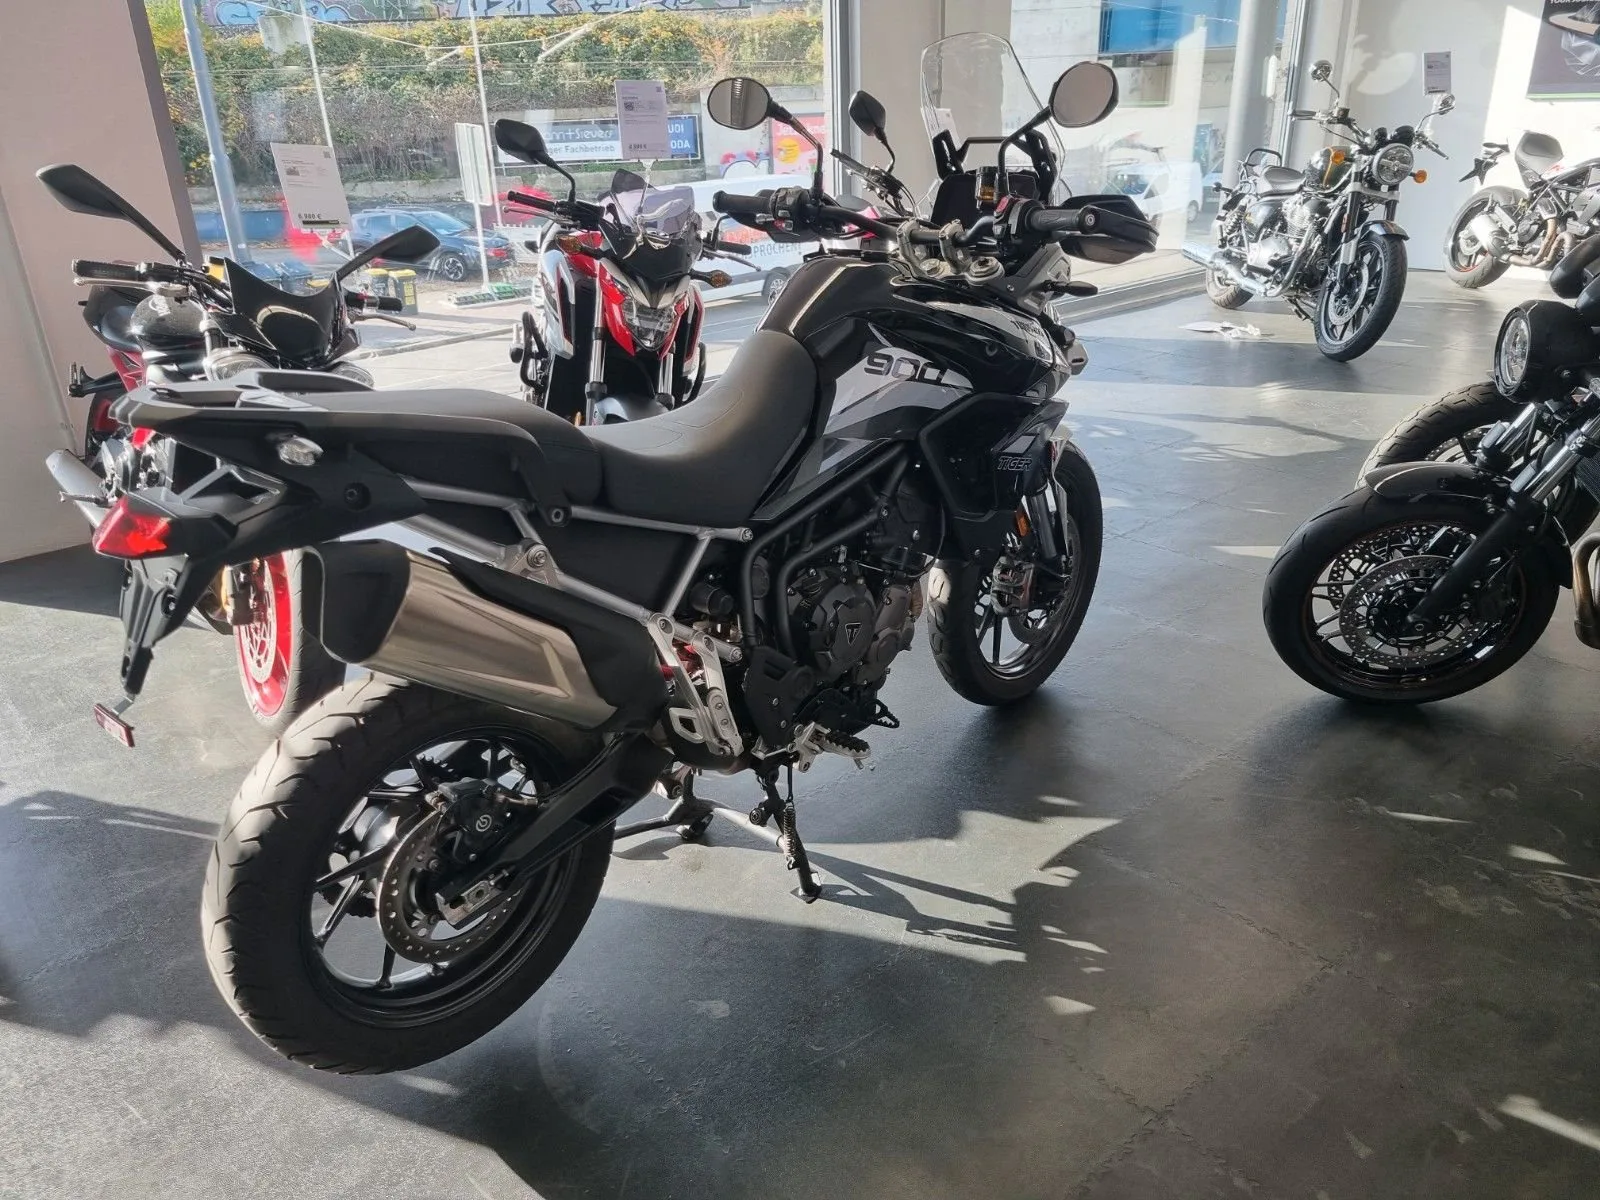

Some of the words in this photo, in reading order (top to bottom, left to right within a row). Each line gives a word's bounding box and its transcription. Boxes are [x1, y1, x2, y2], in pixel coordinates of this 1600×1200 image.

[667, 123, 684, 134] UDI
[564, 144, 615, 153] Fachbetrieb
[670, 139, 691, 149] ODA
[864, 352, 944, 385] 900
[997, 455, 1032, 472] TIGER
